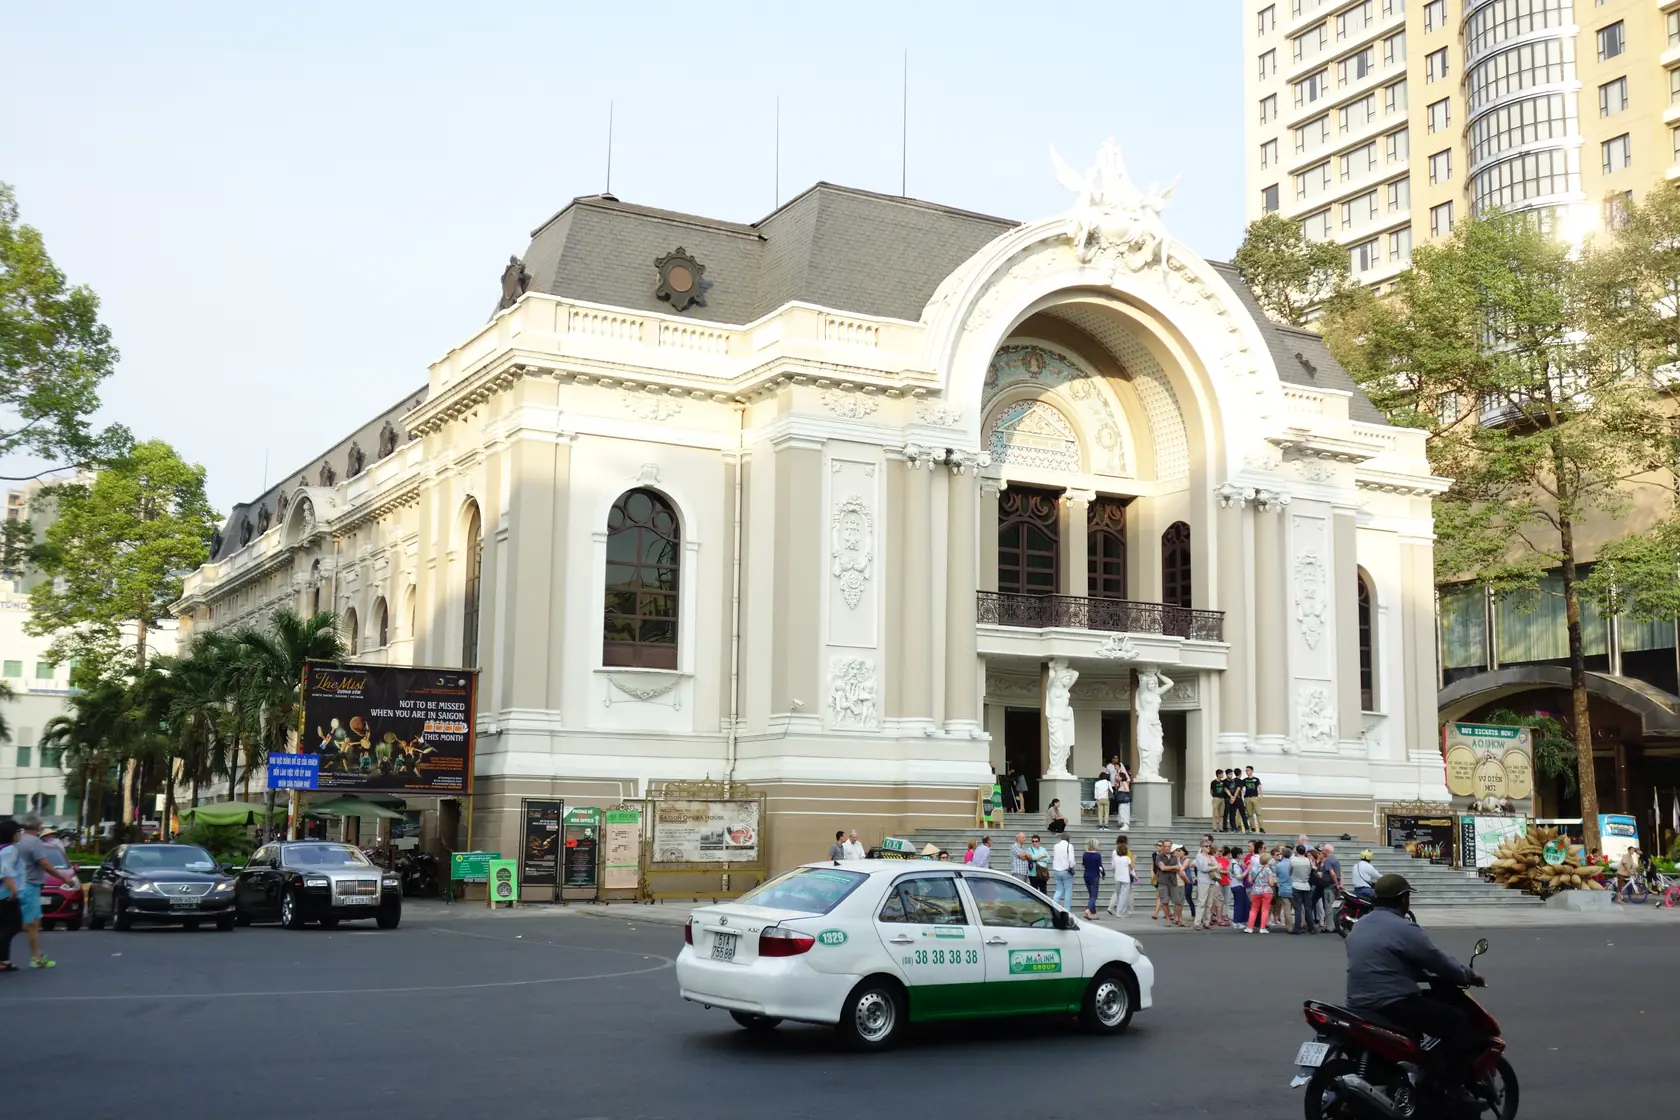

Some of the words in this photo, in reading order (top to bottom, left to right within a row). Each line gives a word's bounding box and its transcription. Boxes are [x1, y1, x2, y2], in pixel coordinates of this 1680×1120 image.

[399, 700, 414, 709] NOT
[416, 701, 426, 709] TO
[427, 701, 437, 709] BE
[438, 702, 465, 711] MISSED
[370, 708, 394, 717] WHEN
[394, 709, 411, 718] YOU
[411, 710, 426, 719] ARE
[427, 711, 436, 719] IN
[437, 712, 465, 720] SAIGON
[424, 733, 439, 741] THIS
[440, 734, 464, 742] MONTH
[718, 934, 730, 947] 51A
[821, 932, 844, 944] 1329
[901, 956, 914, 965] (08)
[915, 950, 928, 964] 38
[932, 950, 945, 964] 38
[949, 950, 962, 964] 38
[965, 949, 978, 964] 38
[1032, 963, 1056, 971] GROUP
